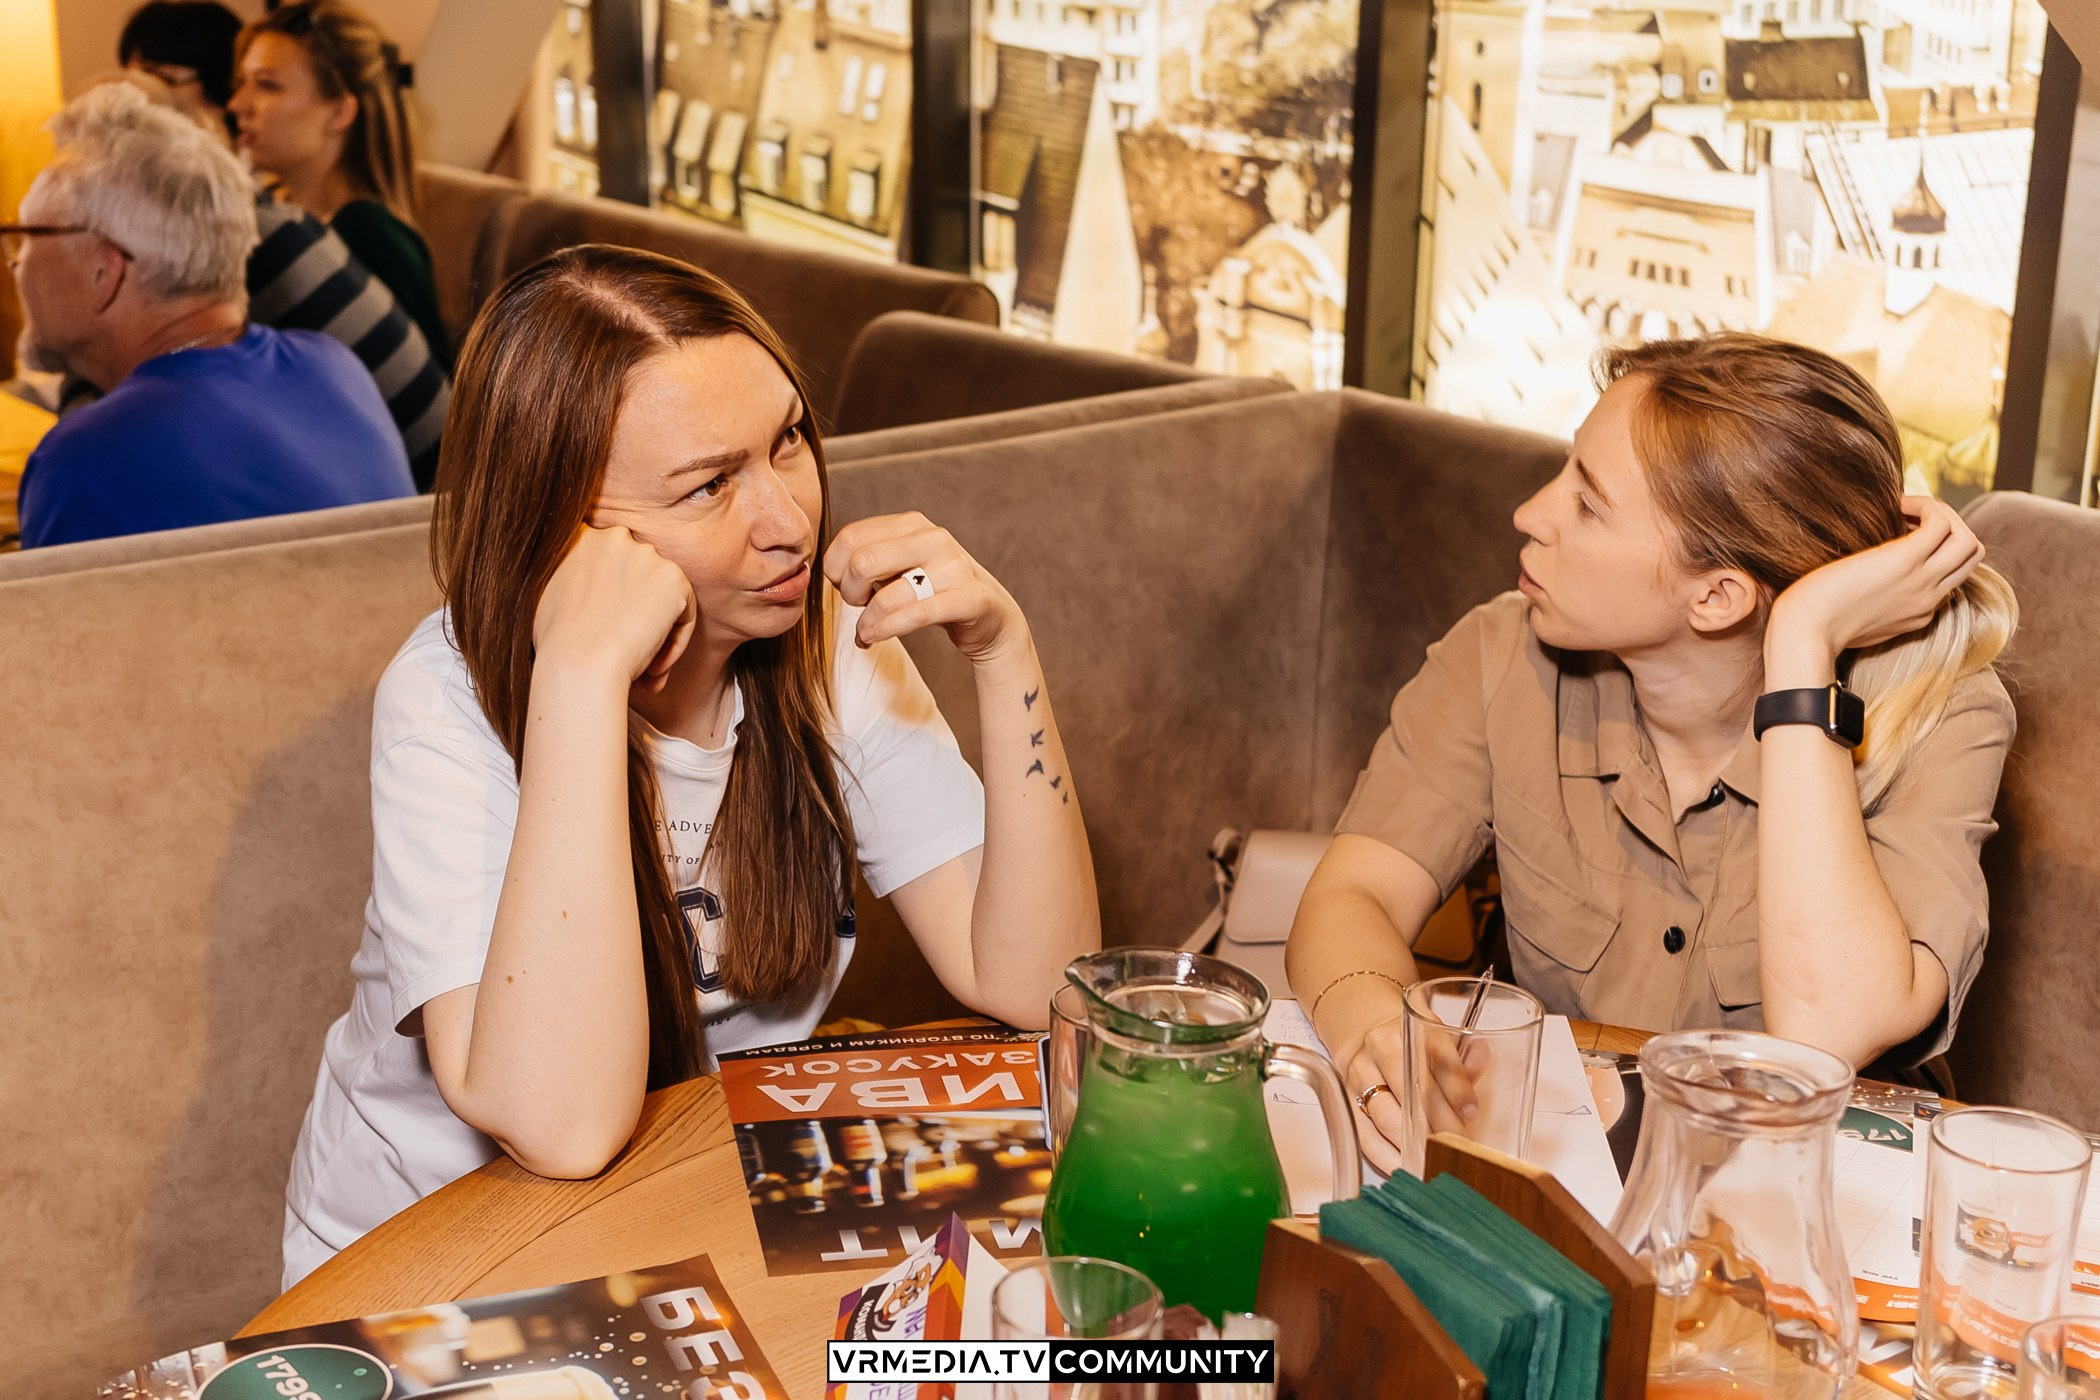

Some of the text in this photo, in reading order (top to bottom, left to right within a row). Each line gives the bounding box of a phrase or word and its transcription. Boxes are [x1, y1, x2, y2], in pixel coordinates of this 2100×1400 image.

[830, 1041, 842, 1049] И
[849, 1034, 965, 1047] ВТОРНИКАМ
[745, 1044, 823, 1056] СРЕДАМ
[760, 1050, 1037, 1079] ЗАКУСОК
[756, 1070, 1040, 1113] ИВА
